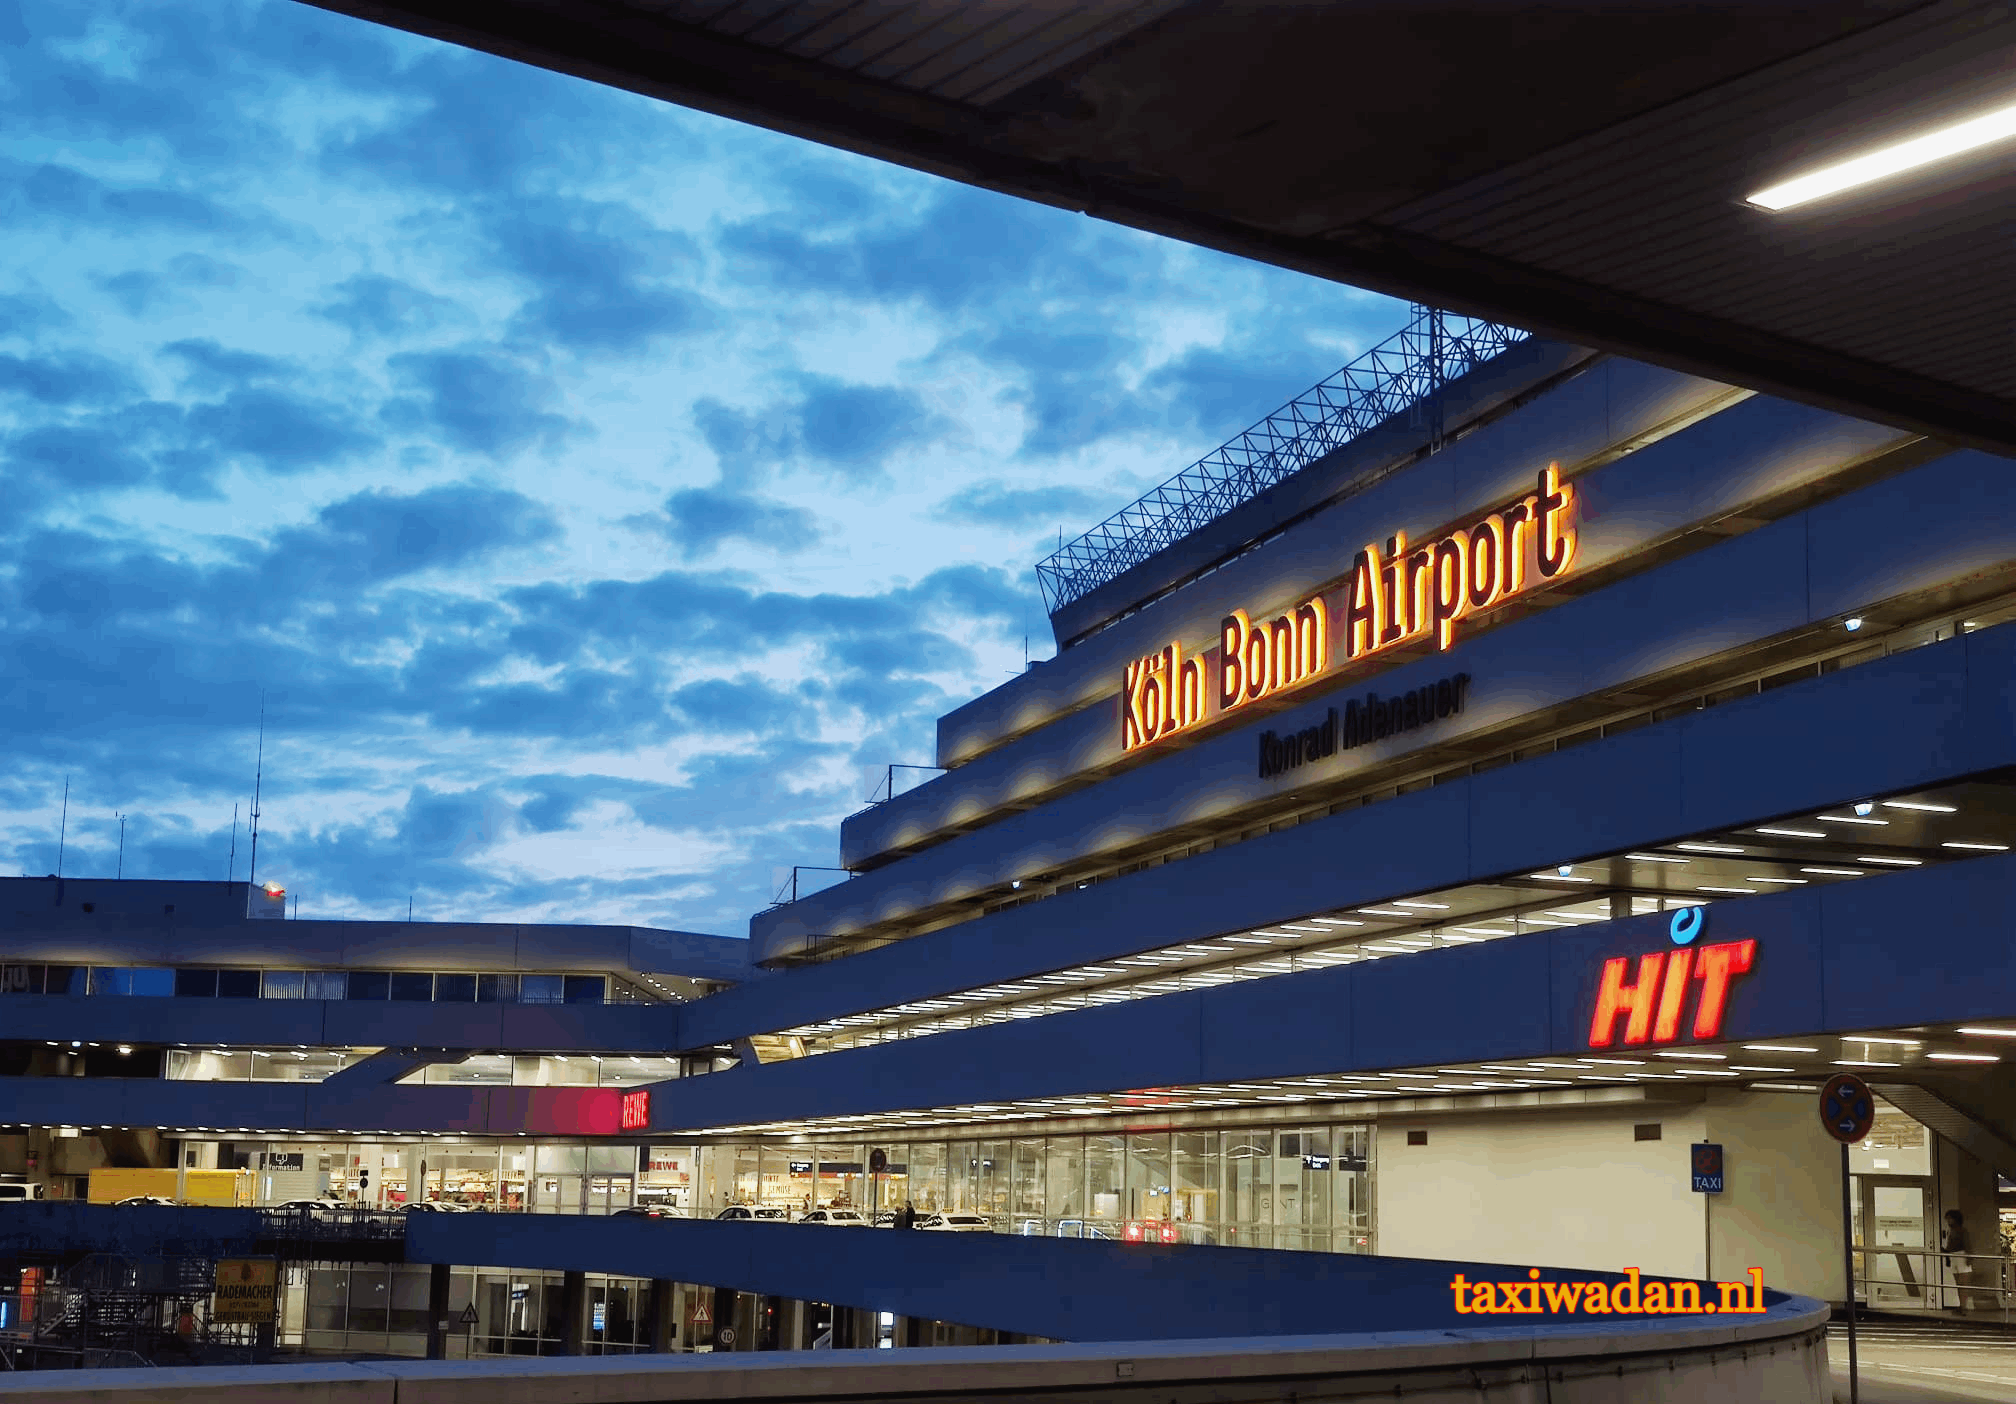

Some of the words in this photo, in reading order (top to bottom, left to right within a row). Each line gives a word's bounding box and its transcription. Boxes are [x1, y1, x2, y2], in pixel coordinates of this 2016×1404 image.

[1122, 639, 1207, 751] Köln
[1220, 597, 1328, 710] Bonn
[1347, 460, 1577, 658] Airport
[1258, 706, 1338, 778] Konrad
[1588, 938, 1757, 1048] HIT
[622, 1091, 648, 1128] REWE
[1693, 1176, 1722, 1189] TAXI
[1260, 1198, 1296, 1209] GNT
[217, 1285, 273, 1299] RADEMACHER
